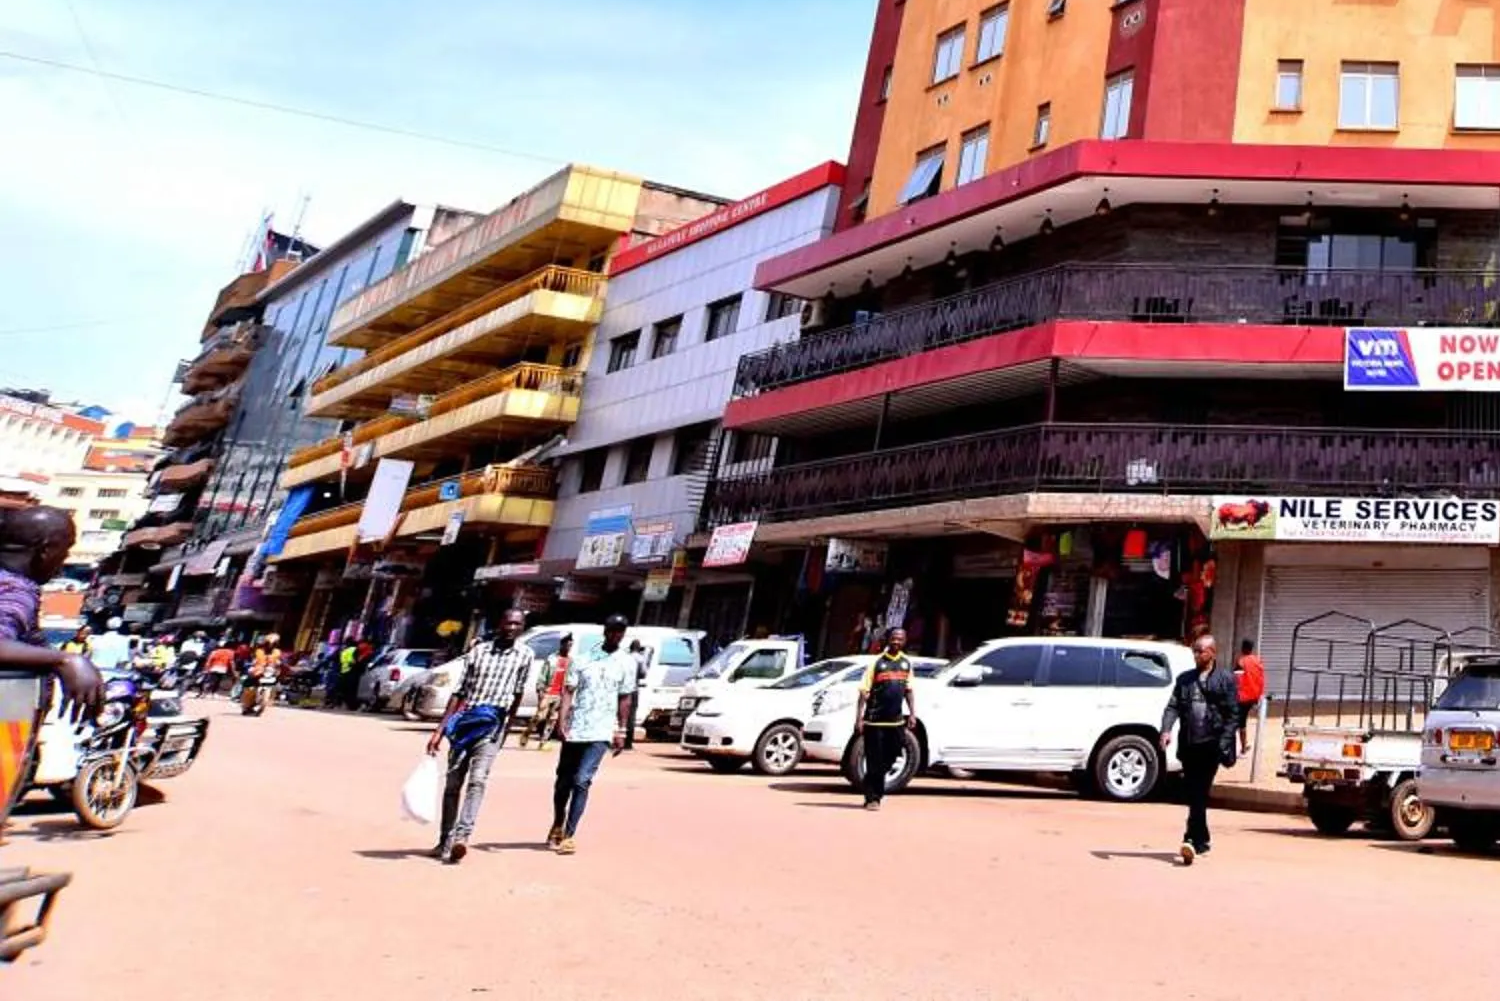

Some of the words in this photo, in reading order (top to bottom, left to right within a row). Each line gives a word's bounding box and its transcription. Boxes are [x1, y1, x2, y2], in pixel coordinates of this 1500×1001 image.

[1440, 334, 1500, 354] NOW
[1280, 499, 1342, 518] NILE
[1355, 499, 1497, 522] SERVICES
[1302, 520, 1389, 531] VETERINARY
[1399, 521, 1477, 532] PHARMACY
